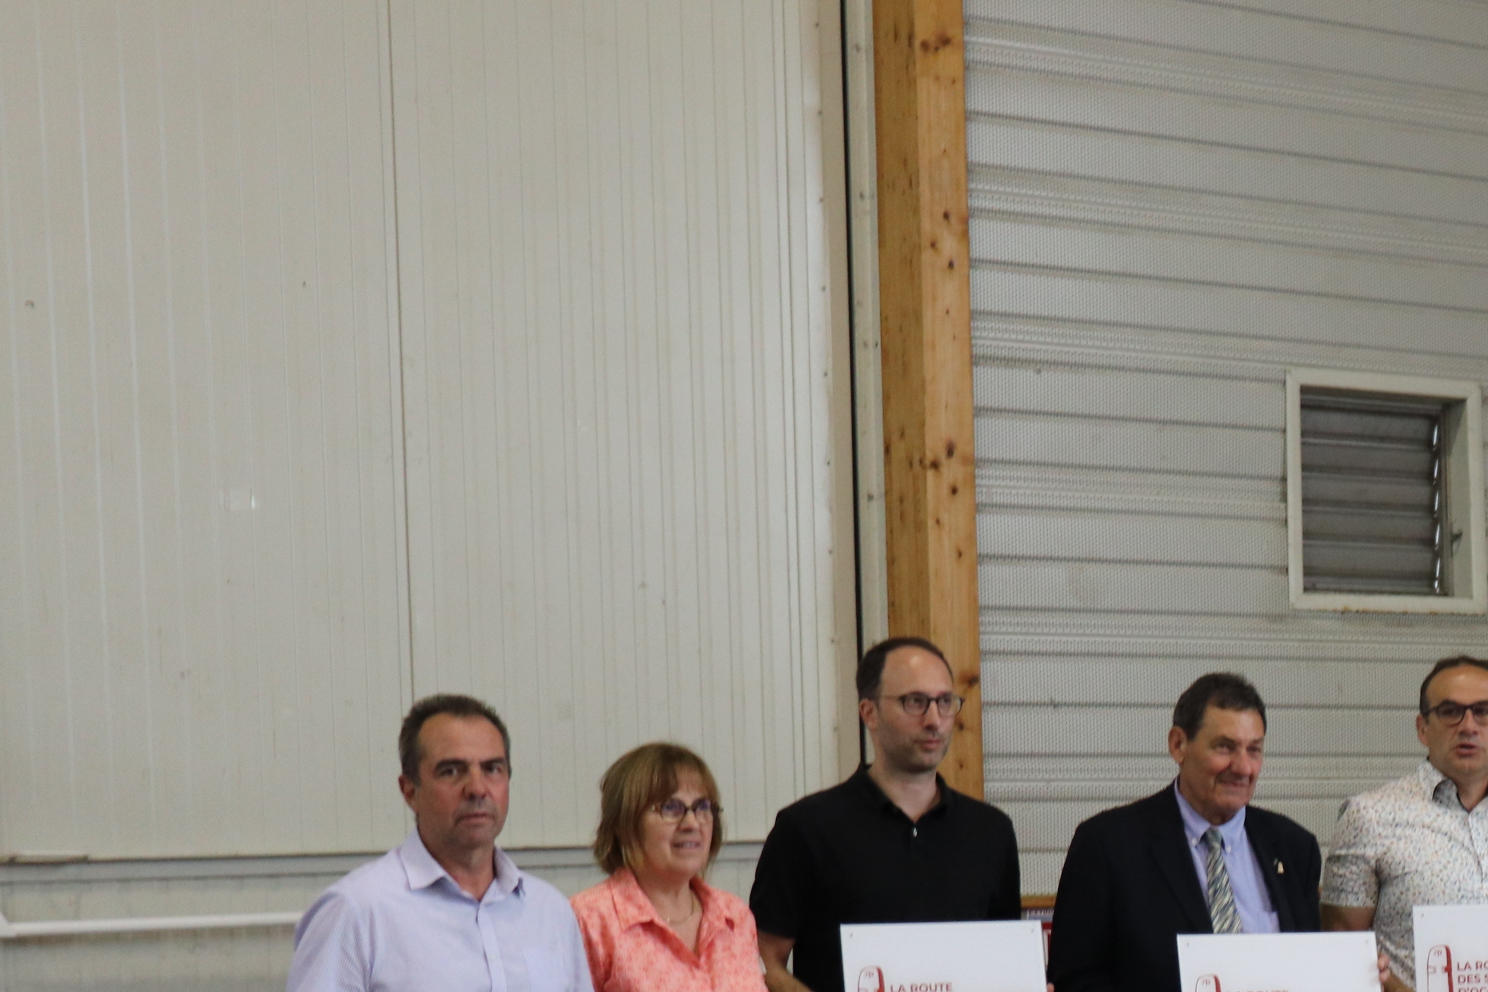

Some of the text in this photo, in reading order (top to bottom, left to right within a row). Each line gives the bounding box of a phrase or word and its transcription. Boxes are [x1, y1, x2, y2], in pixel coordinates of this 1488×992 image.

[1457, 961, 1472, 971] LA
[1458, 972, 1482, 983] DES
[910, 982, 953, 992] ROUTE
